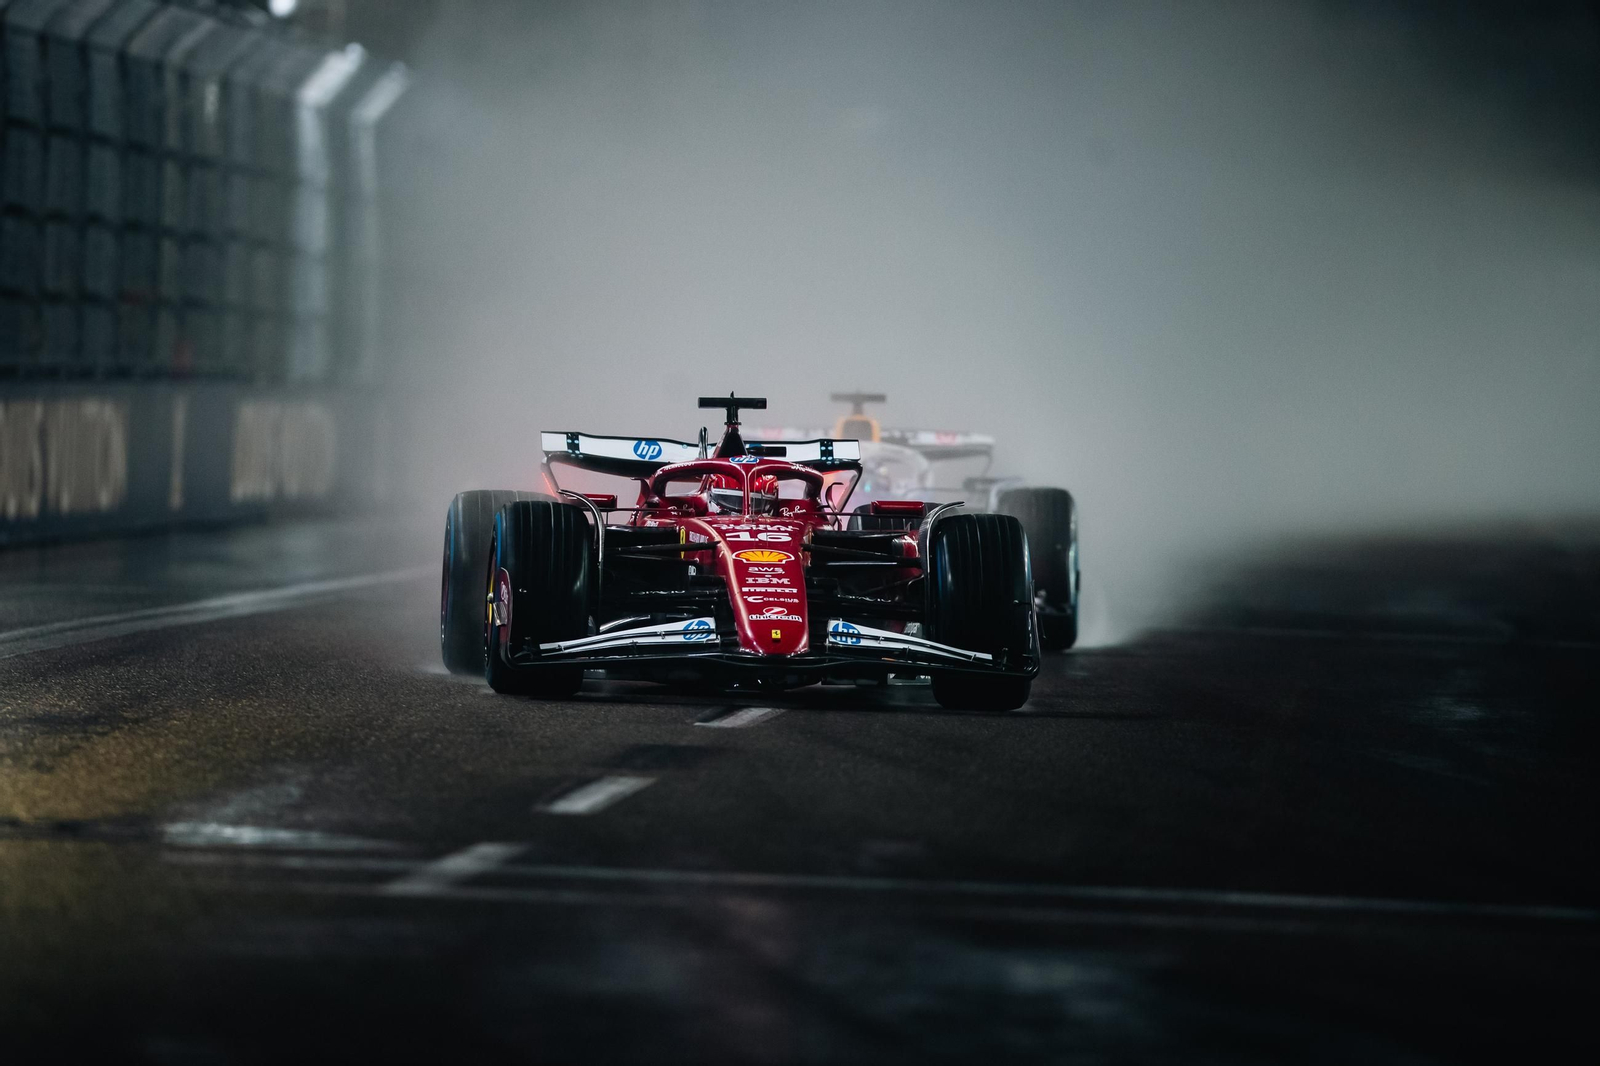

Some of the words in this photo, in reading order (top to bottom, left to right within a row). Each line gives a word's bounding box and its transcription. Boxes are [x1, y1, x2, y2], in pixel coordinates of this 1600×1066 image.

[637, 440, 660, 461] hp
[725, 531, 792, 542] 16
[748, 566, 785, 574] aws
